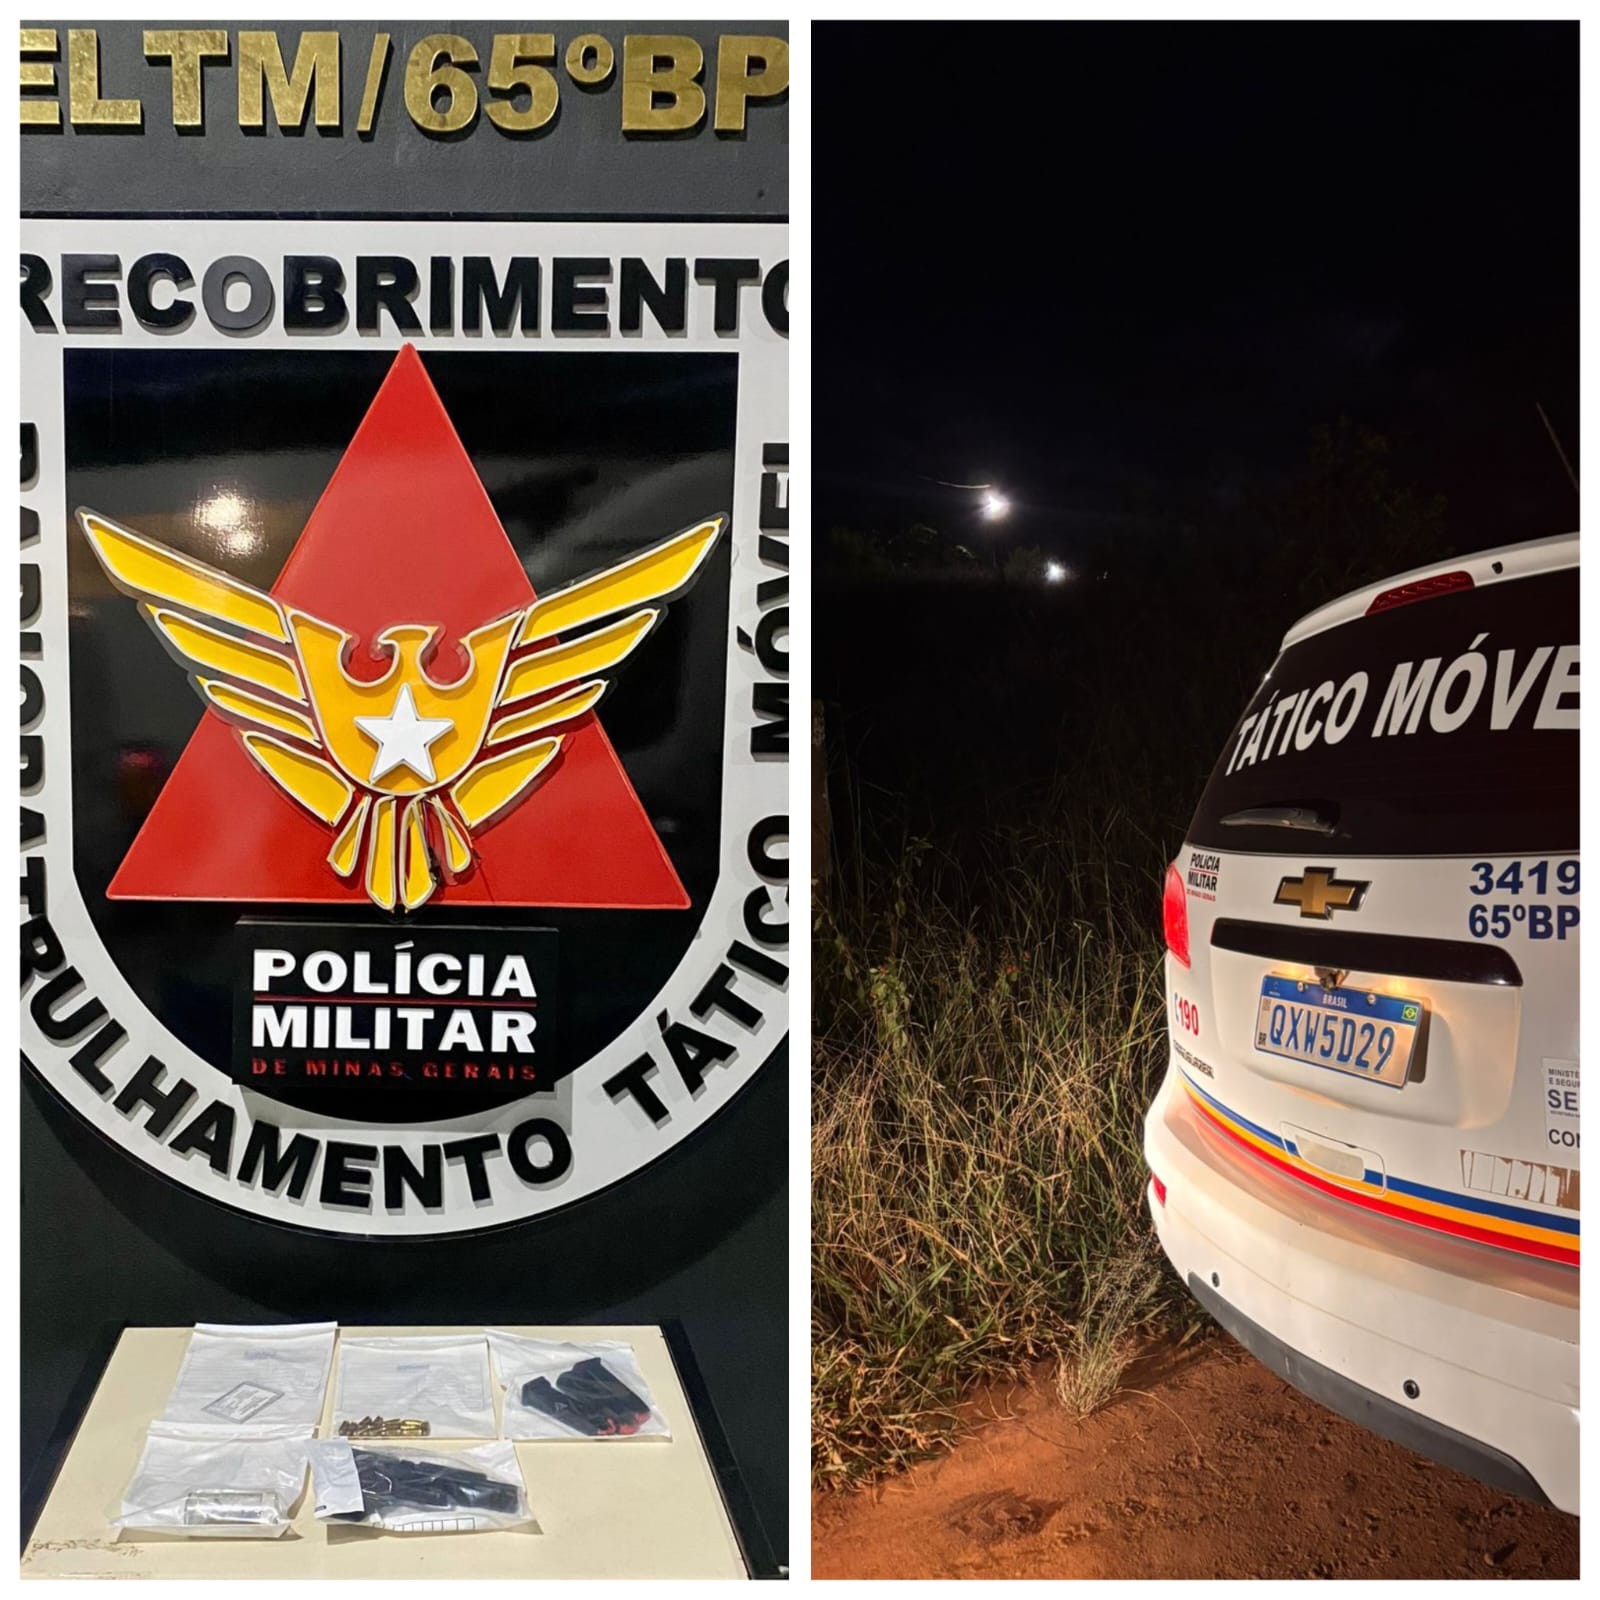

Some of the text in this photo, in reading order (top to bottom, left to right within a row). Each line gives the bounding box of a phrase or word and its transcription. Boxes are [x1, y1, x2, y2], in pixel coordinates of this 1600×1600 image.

[1225, 632, 1580, 777] TÁTICO MÓVE
[1469, 860, 1580, 895] 3419
[253, 940, 538, 997] POLÍCIA
[602, 814, 789, 1130] TÁTICO
[1179, 997, 1199, 1036] 190
[1322, 993, 1349, 1009] BRASIL
[251, 1005, 537, 1053] MILITAR
[1270, 1004, 1395, 1074] QXW5D29
[251, 1058, 537, 1081] DE MINAS GERAIS
[1548, 1089, 1579, 1111] SE
